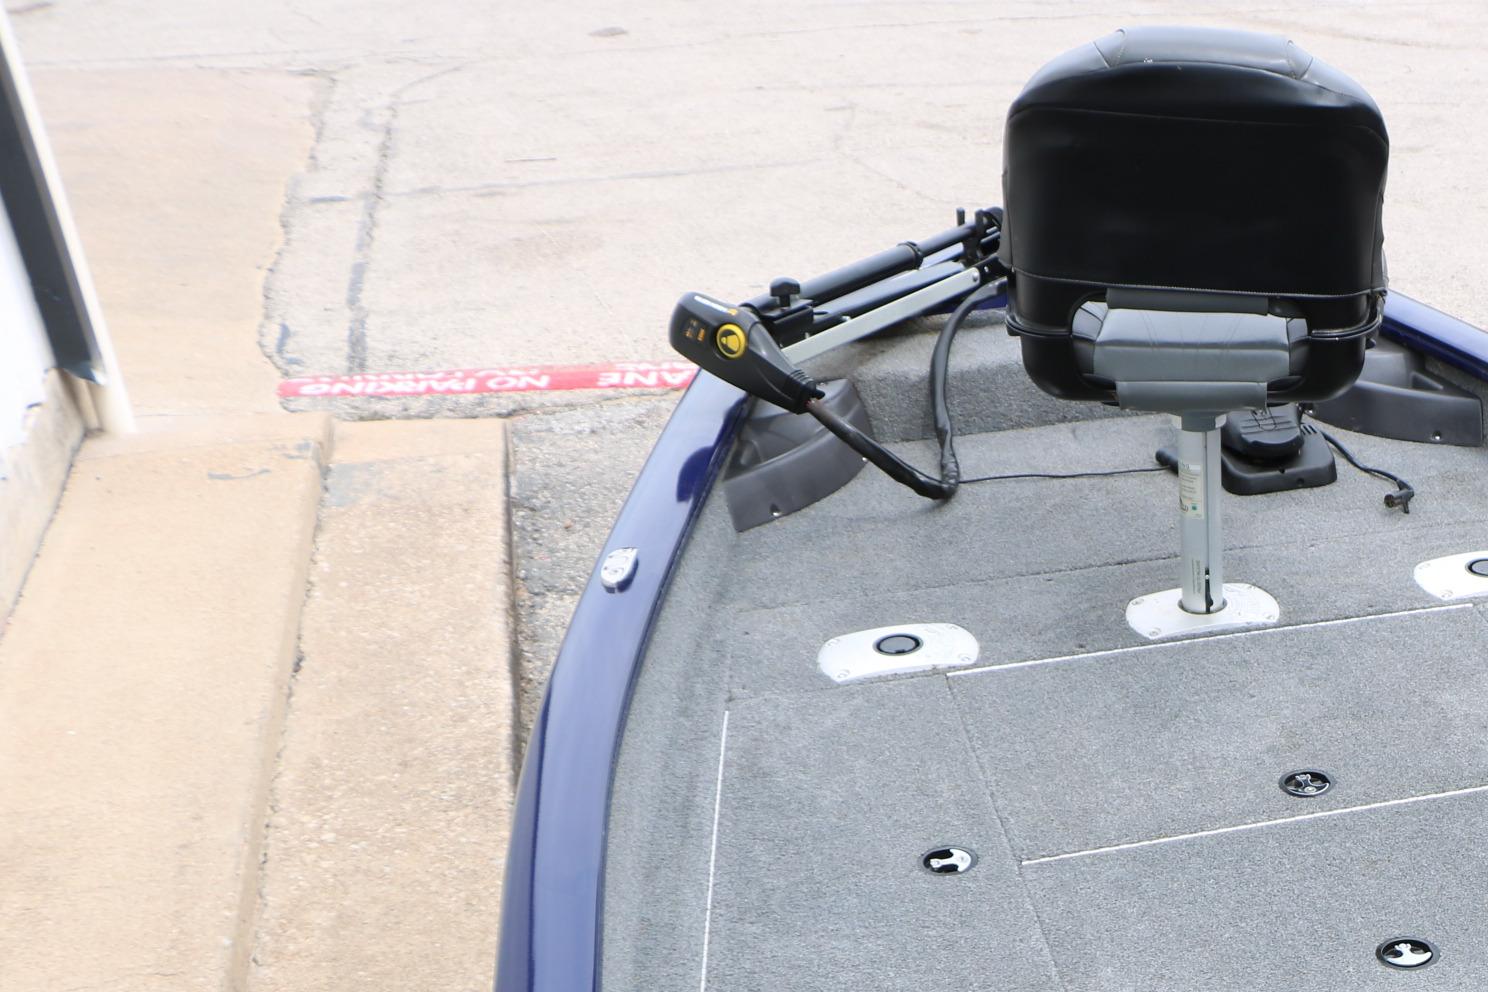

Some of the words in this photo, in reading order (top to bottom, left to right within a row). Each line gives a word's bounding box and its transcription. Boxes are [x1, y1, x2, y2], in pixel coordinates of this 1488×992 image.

[301, 378, 476, 396] PARKING
[486, 375, 549, 389] NO
[596, 371, 692, 388] ANE
